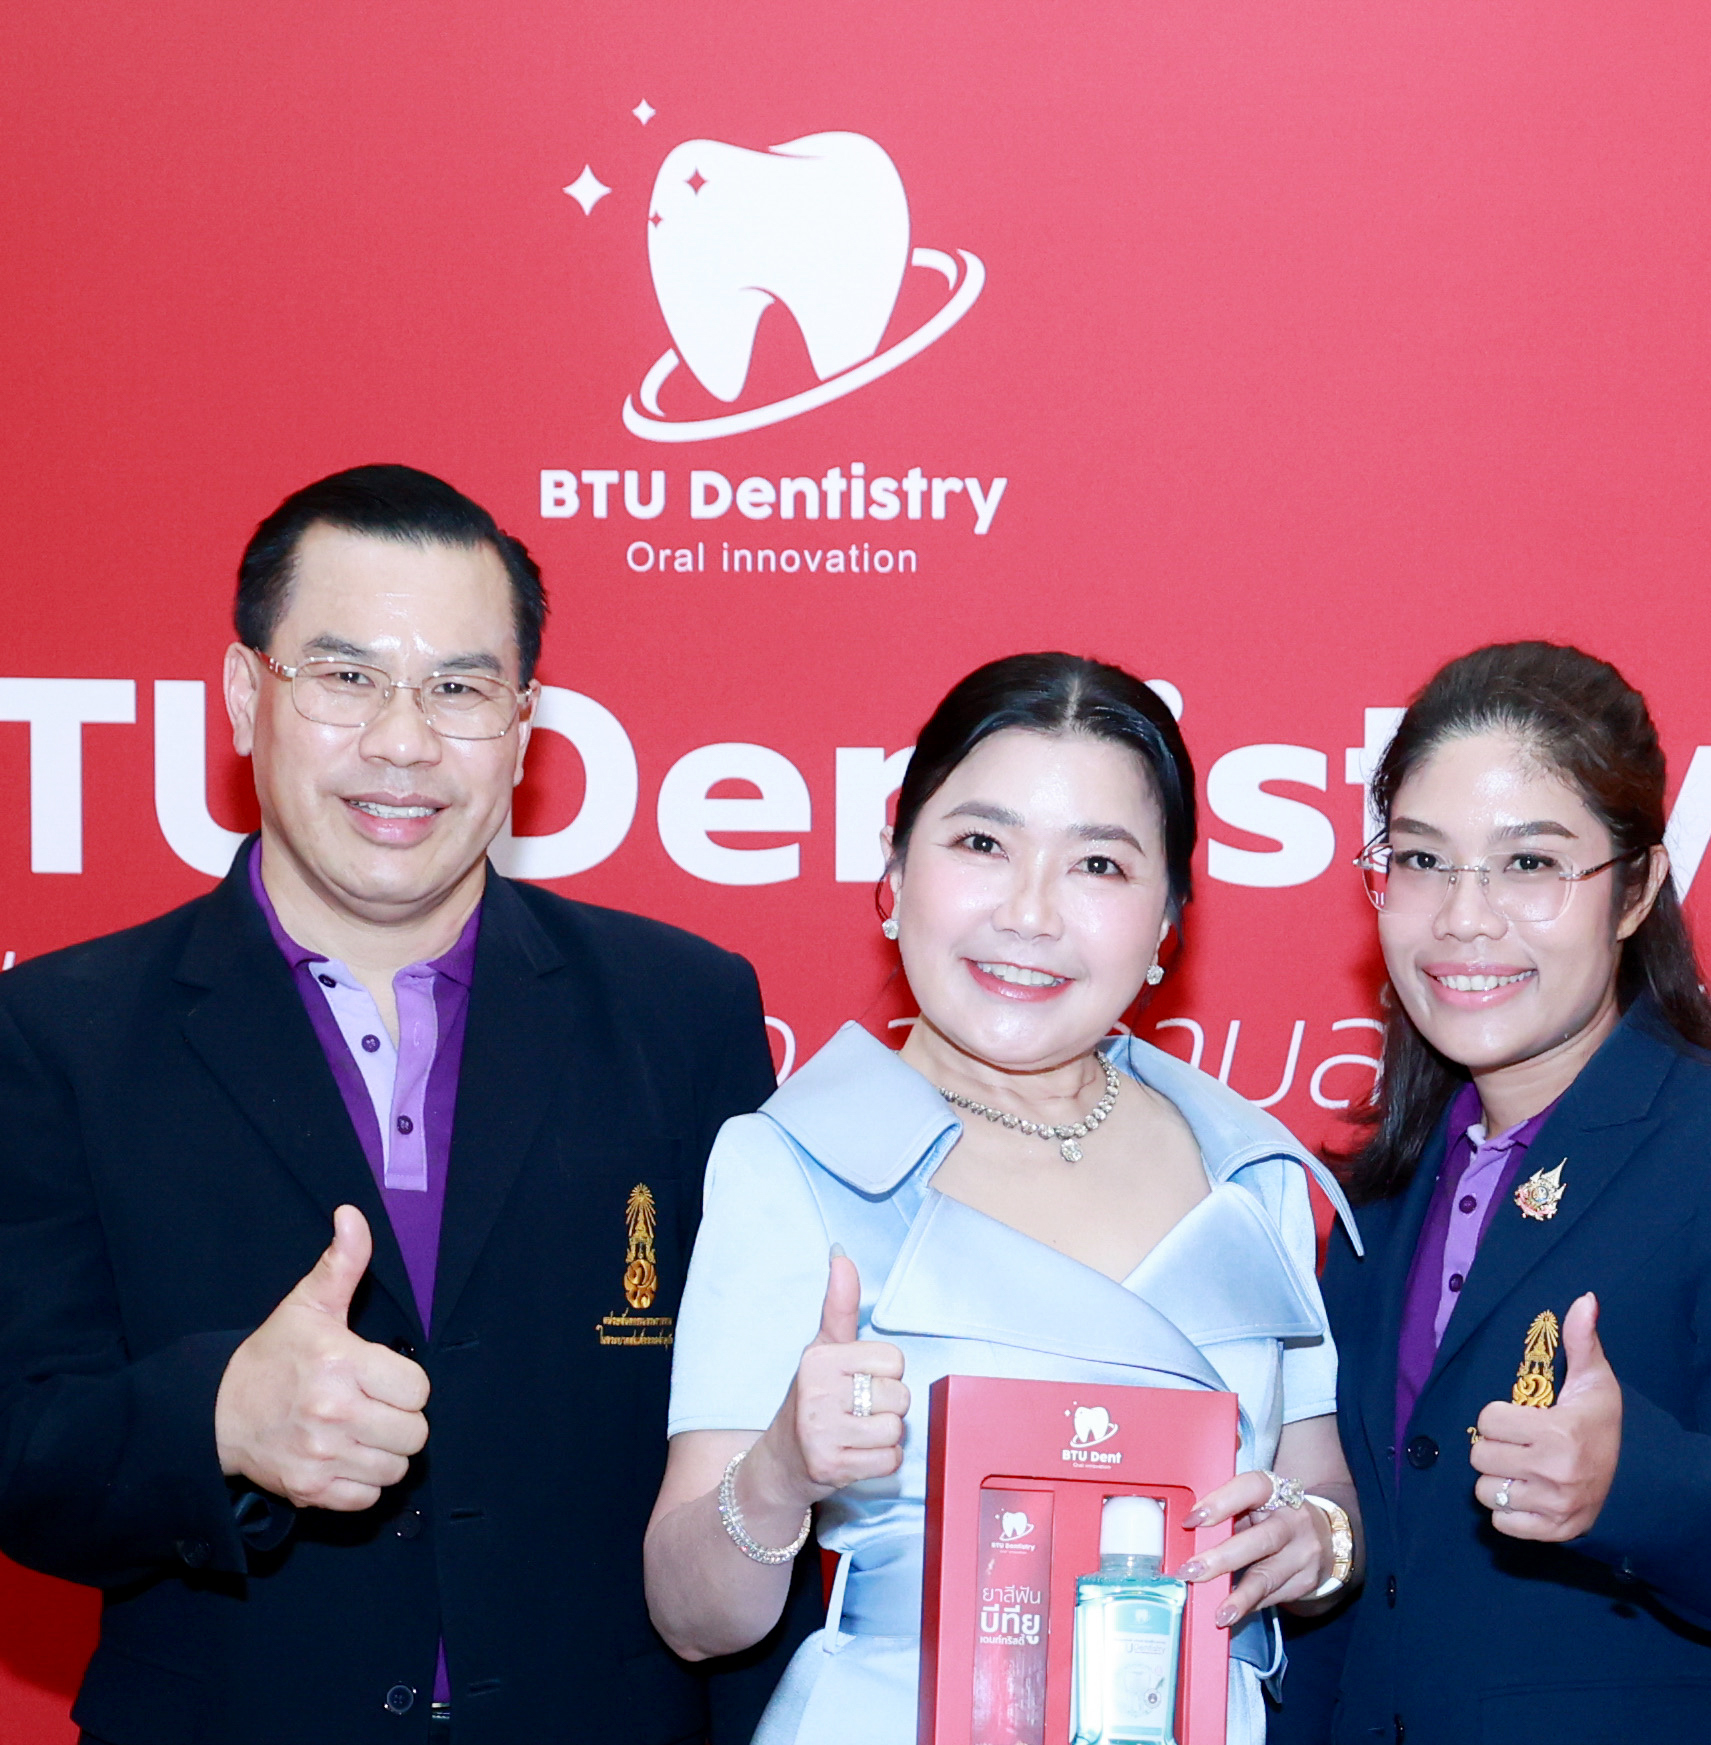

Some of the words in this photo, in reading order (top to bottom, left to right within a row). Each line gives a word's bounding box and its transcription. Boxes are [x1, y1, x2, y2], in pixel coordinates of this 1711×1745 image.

[540, 469, 666, 519] BTU
[690, 462, 1008, 535] Dentistry
[626, 541, 704, 573] Oral
[722, 542, 918, 573] innovation
[1062, 1449, 1088, 1462] BTU
[1090, 1451, 1122, 1464] Dent
[982, 1585, 1041, 1604] ยาสีฟัน
[980, 1603, 1041, 1645] บีทียู
